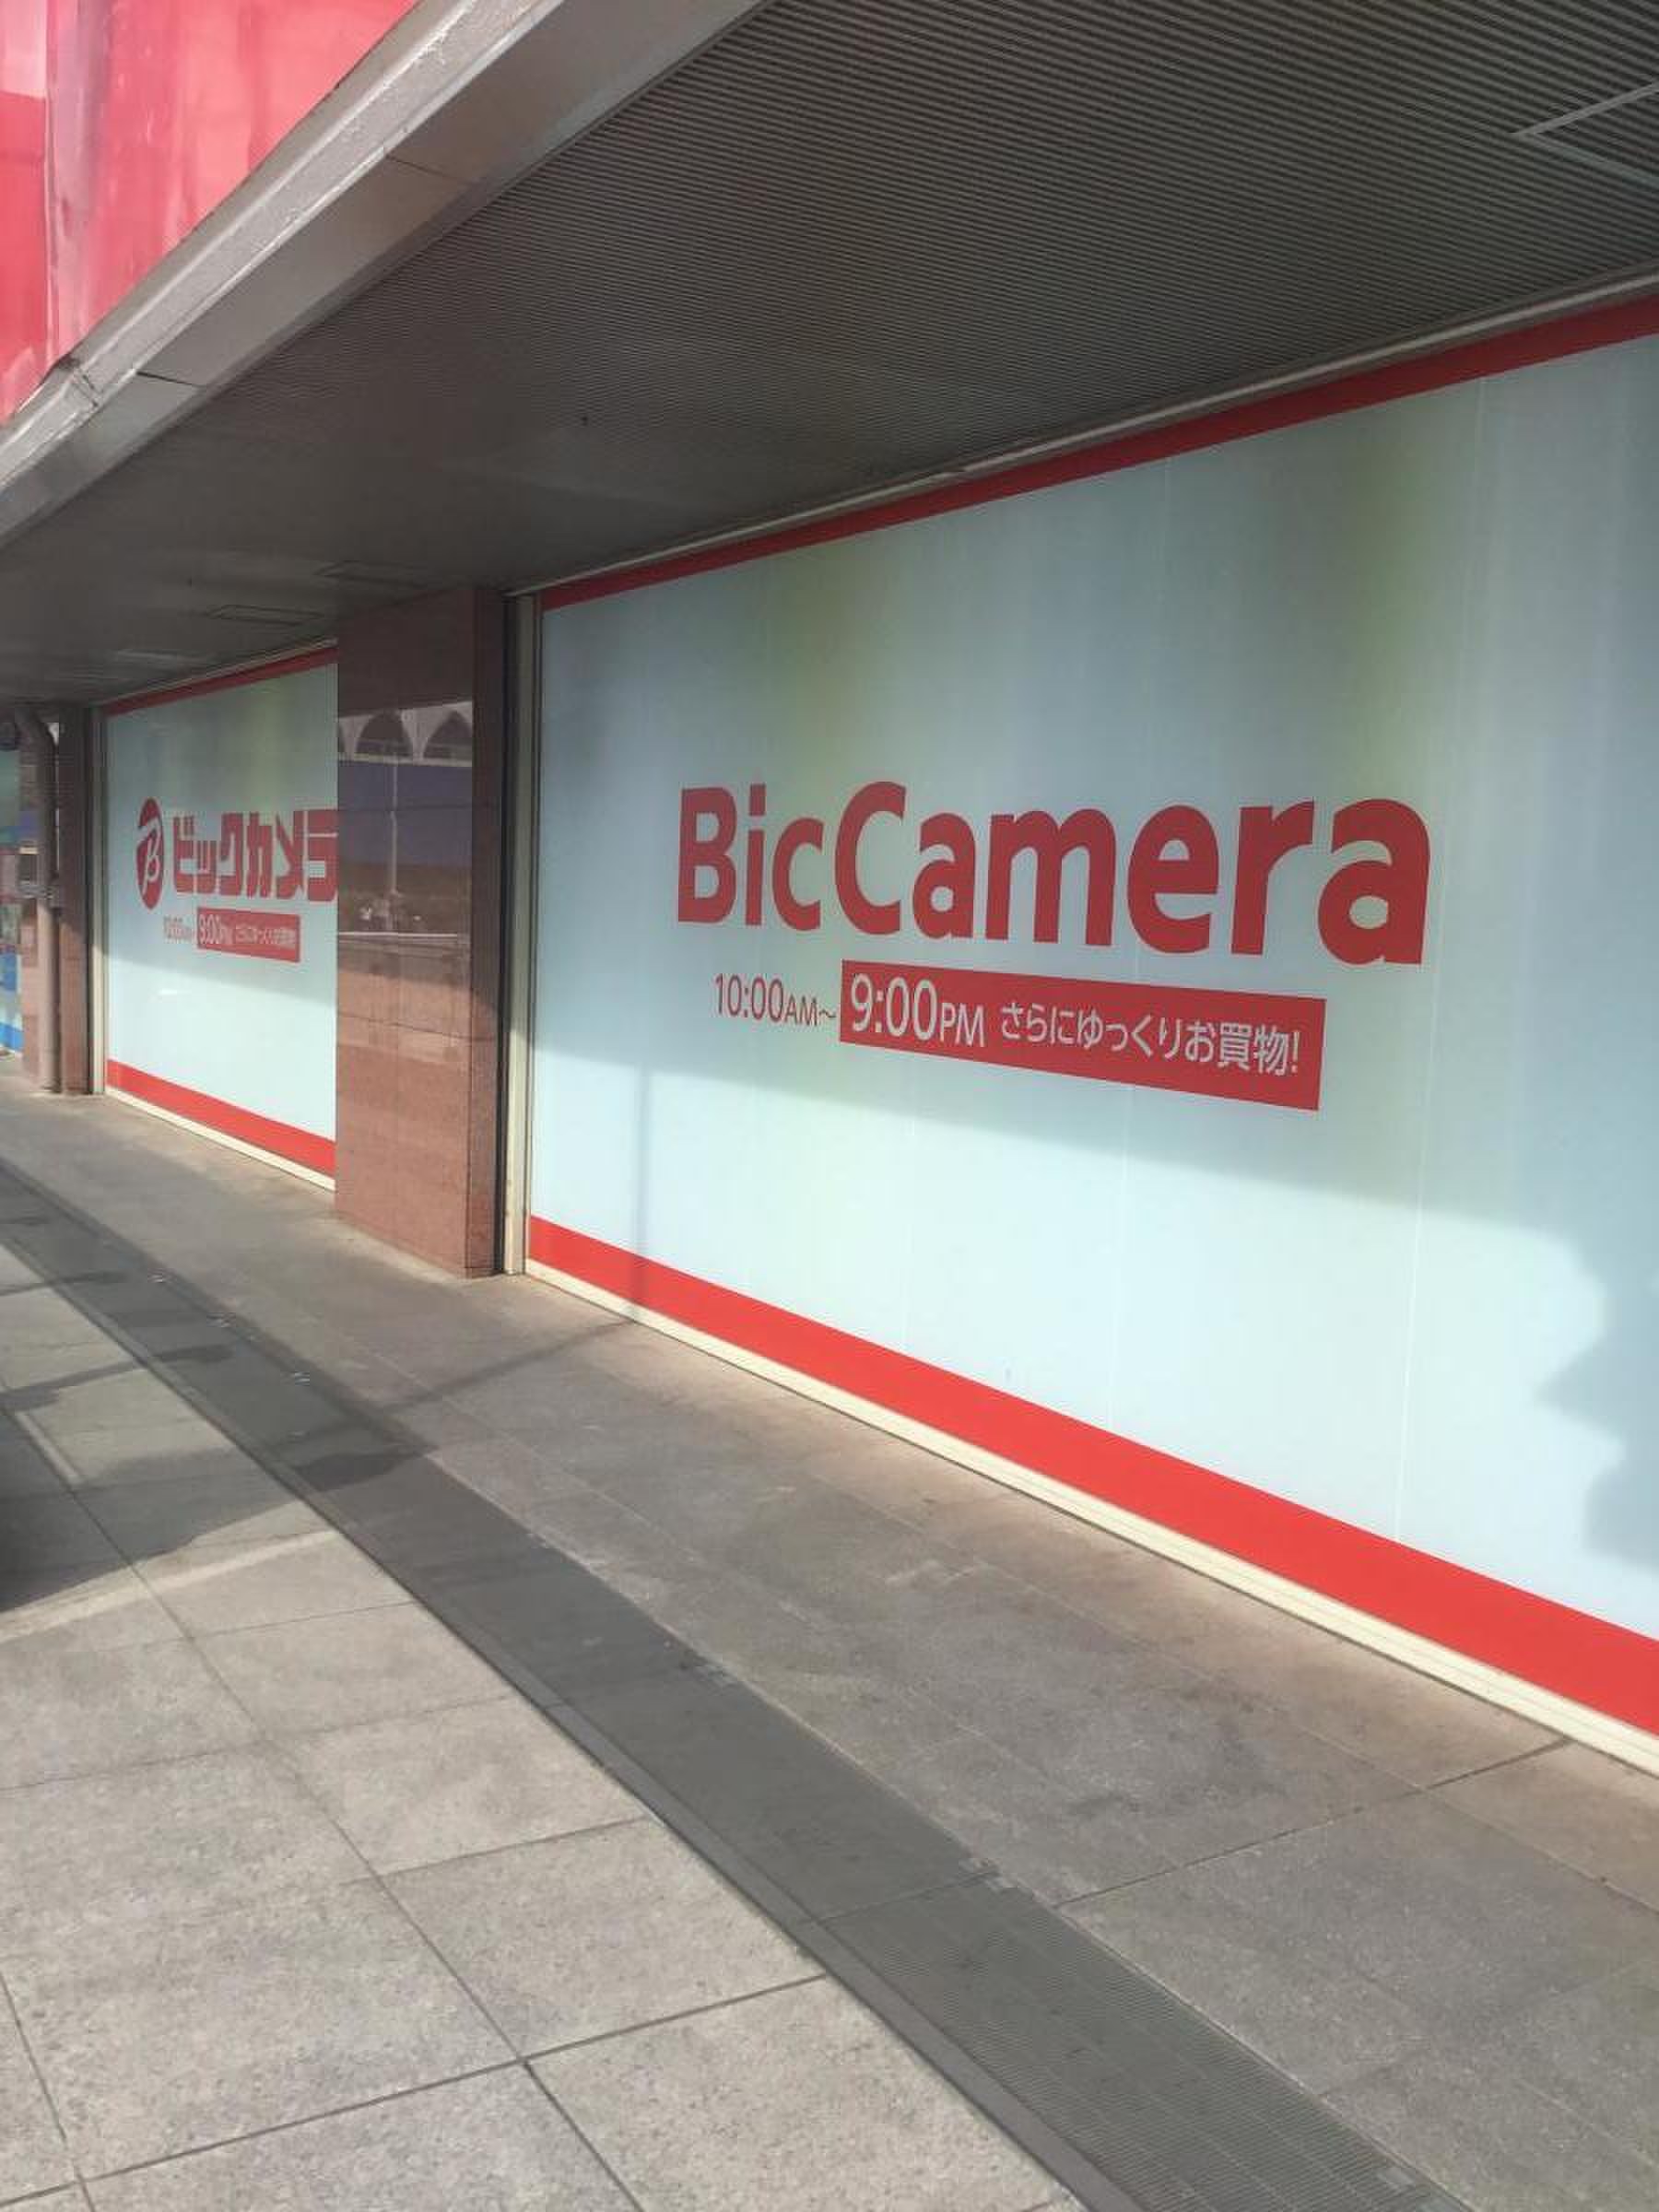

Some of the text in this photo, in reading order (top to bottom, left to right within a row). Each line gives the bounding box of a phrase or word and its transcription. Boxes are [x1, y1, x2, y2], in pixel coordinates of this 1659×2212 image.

[172, 807, 338, 902] ビックカメラ
[678, 782, 1430, 966] BicCamera
[849, 972, 986, 1048] 9:00PM
[1000, 1002, 1300, 1077] さらにゆっくりお買物!
